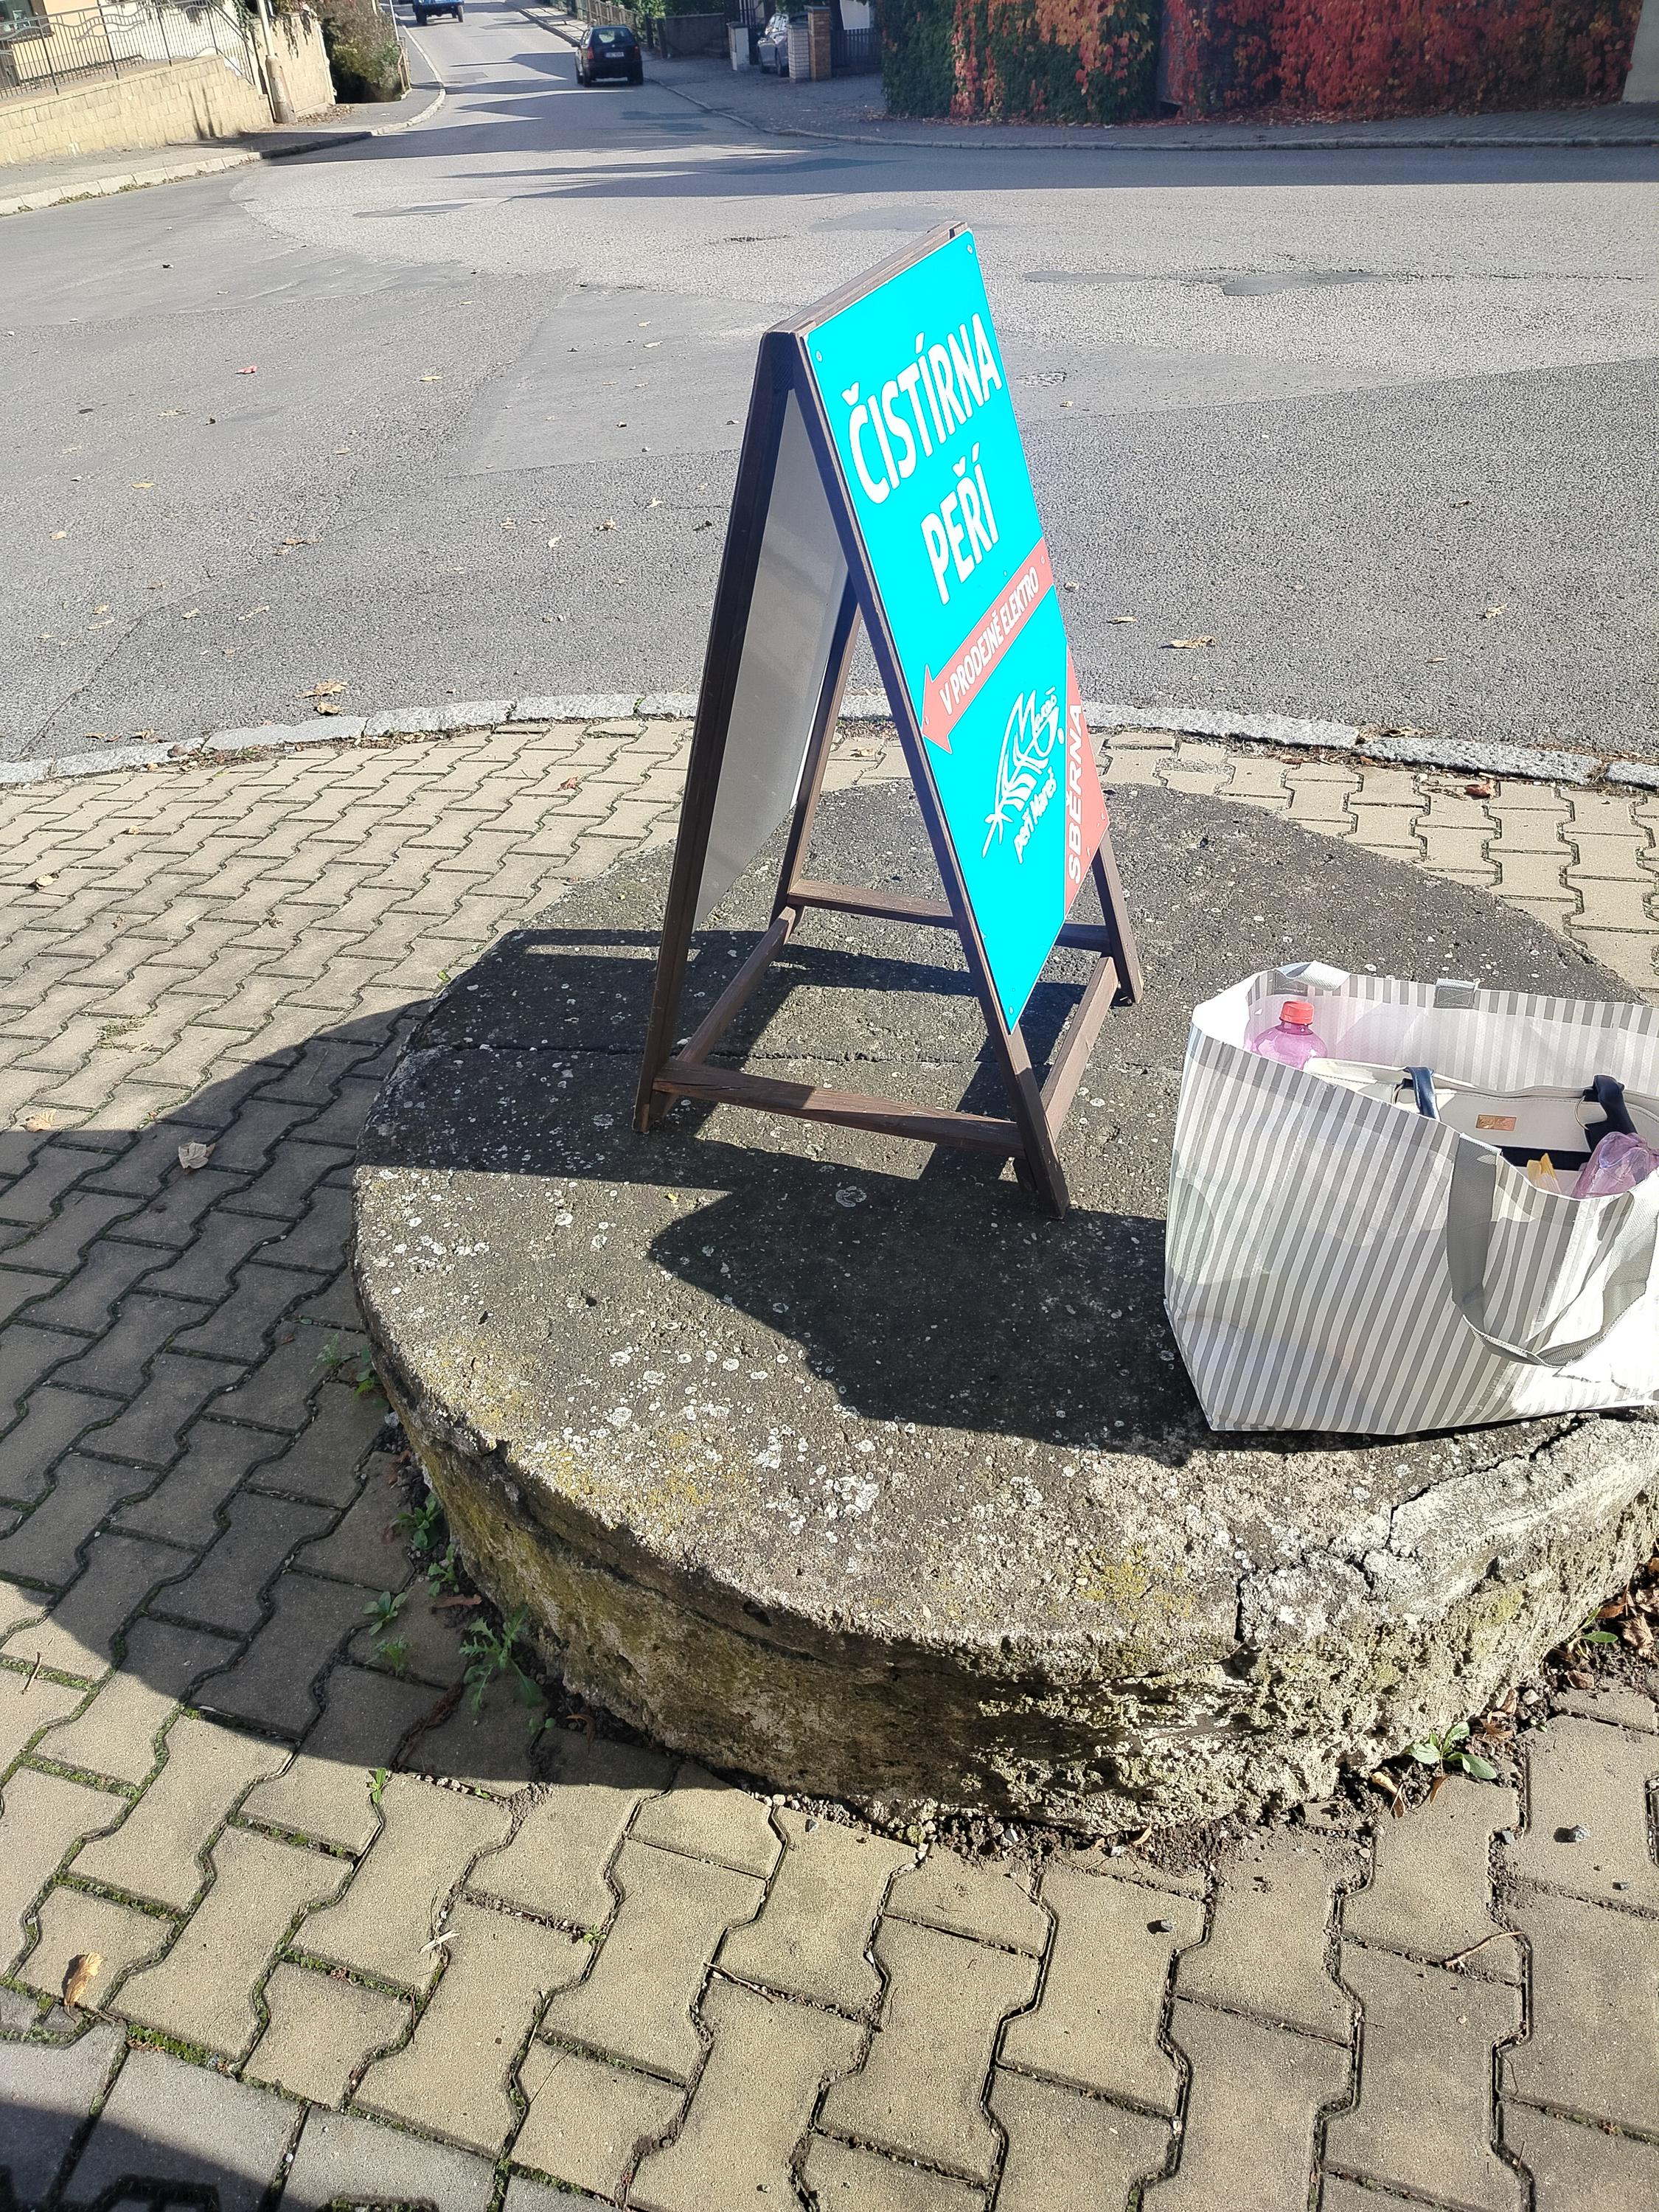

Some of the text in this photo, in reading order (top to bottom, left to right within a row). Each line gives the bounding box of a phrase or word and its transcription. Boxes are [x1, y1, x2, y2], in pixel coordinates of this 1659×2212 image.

[841, 313, 1003, 504] ČISTÍRNA
[920, 442, 999, 605] PEŘÍ
[939, 566, 1039, 715] V PRODEJNĚ ELEKTRO
[1066, 705, 1082, 884] SBĚRNA
